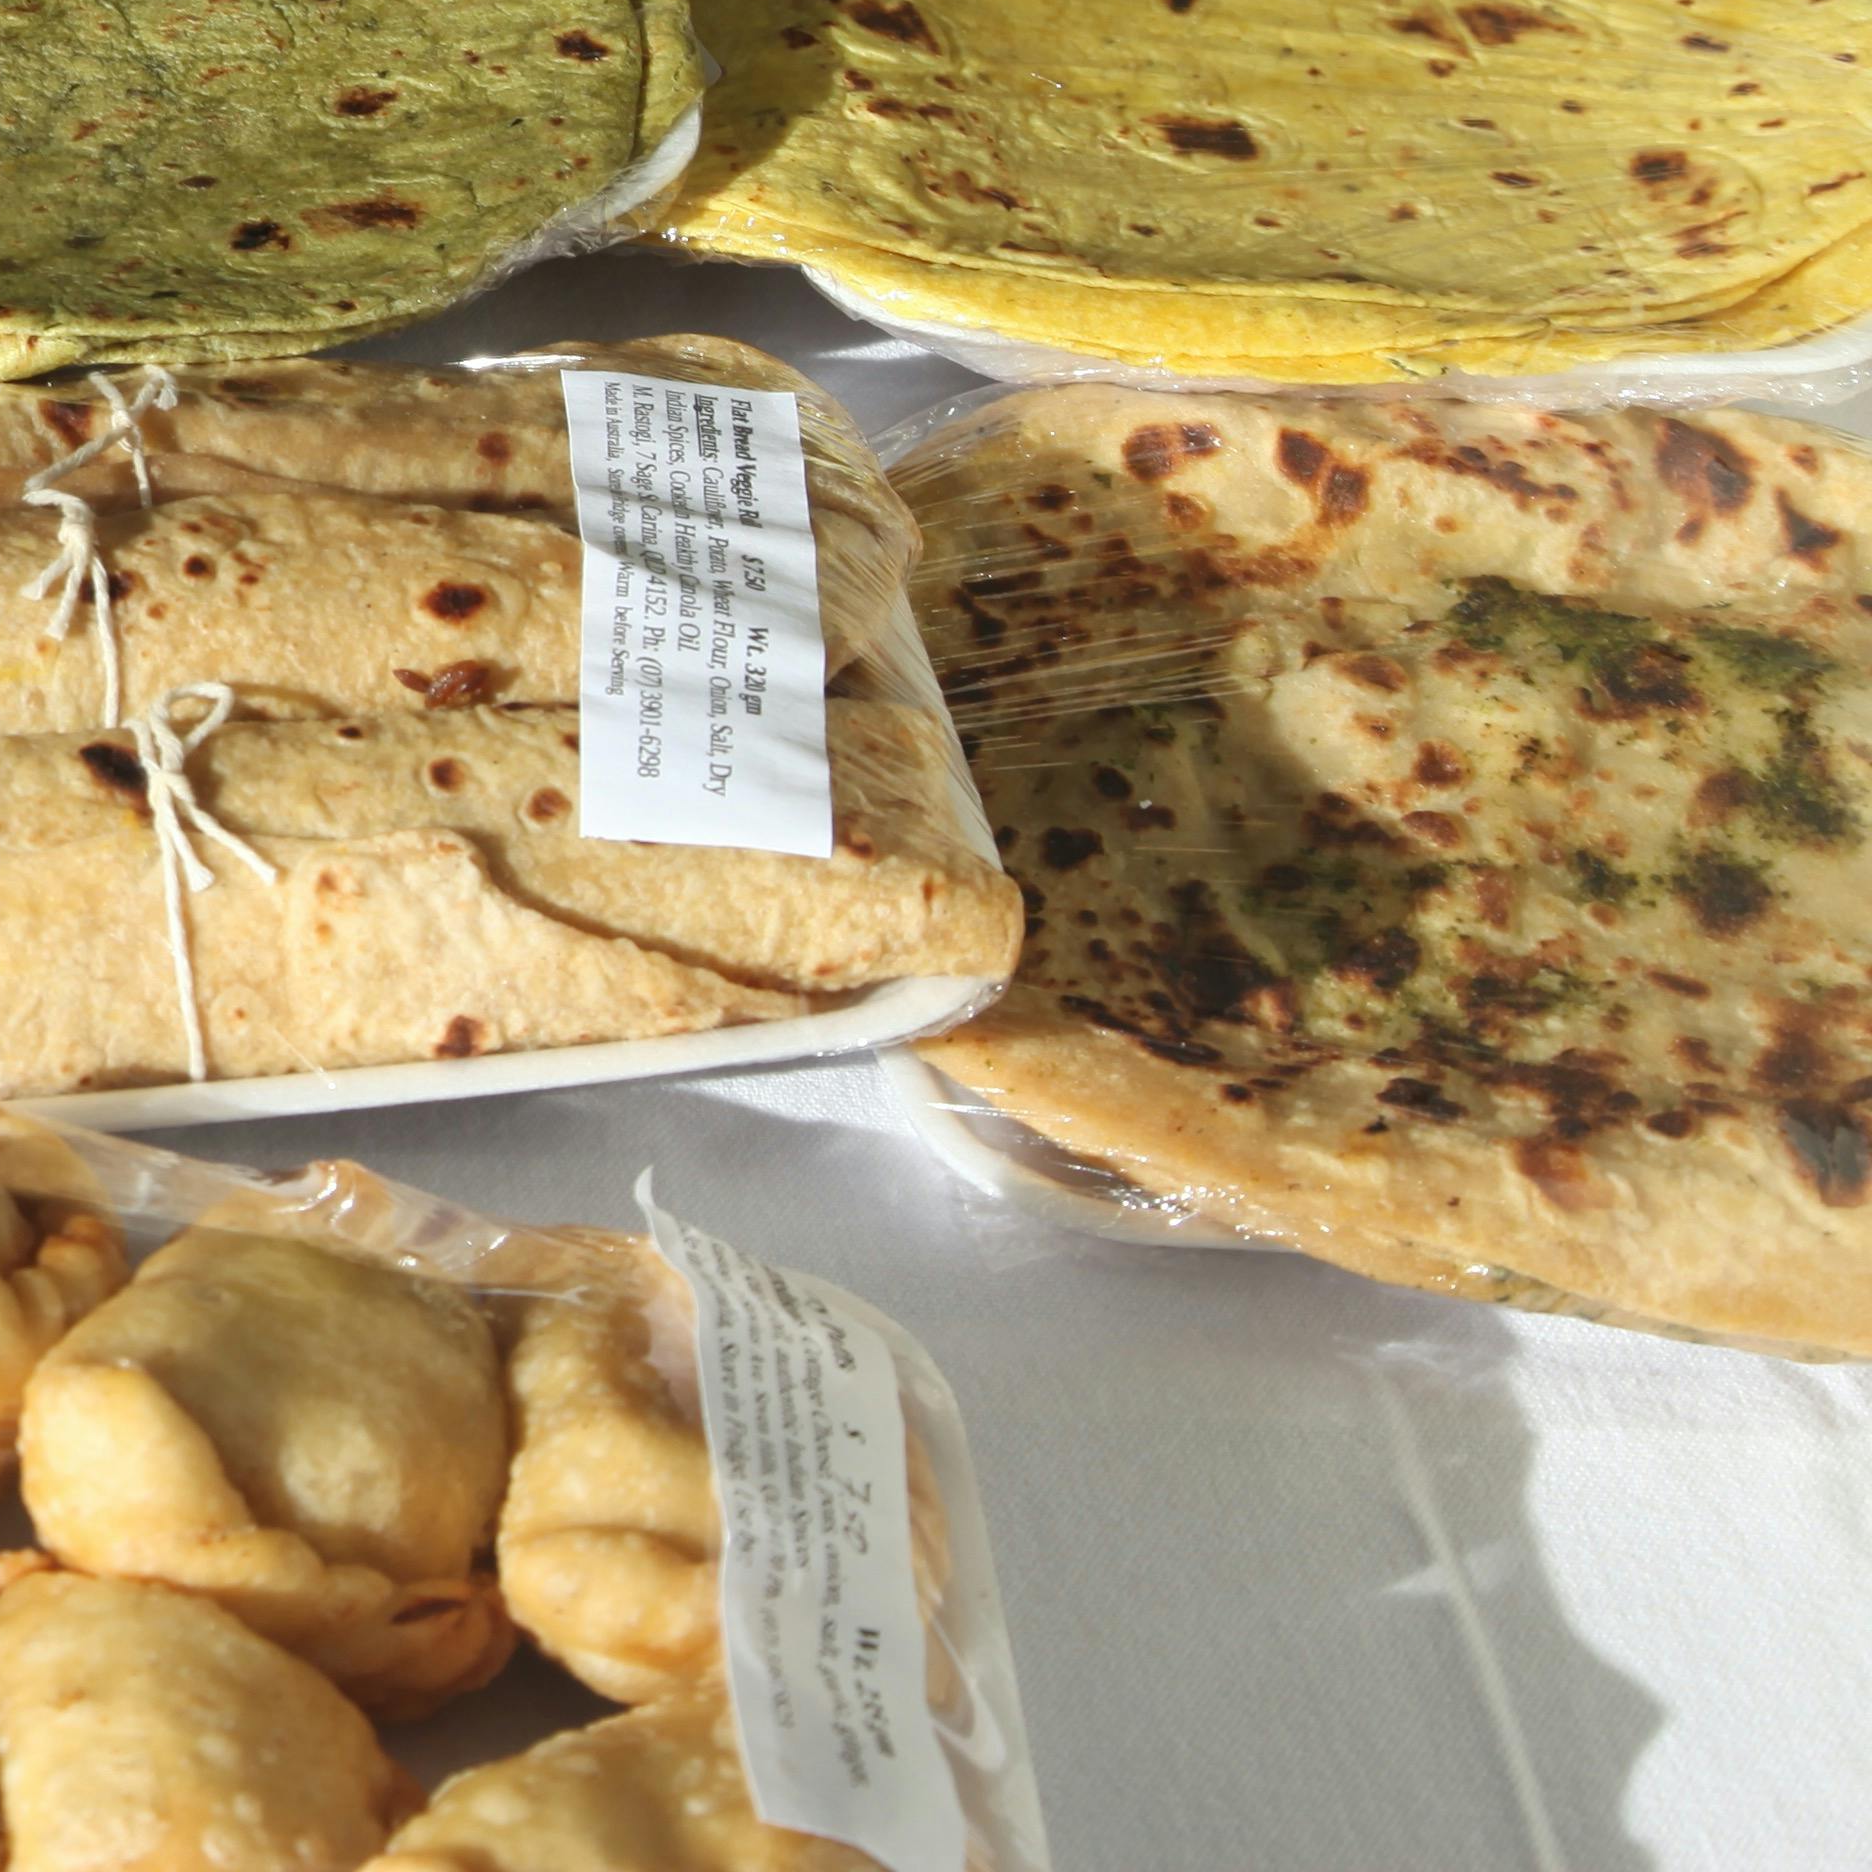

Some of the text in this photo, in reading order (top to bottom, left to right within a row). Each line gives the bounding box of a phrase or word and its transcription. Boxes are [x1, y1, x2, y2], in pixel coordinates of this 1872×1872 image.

[603, 381, 622, 405] Made
[631, 384, 653, 398] M.
[664, 389, 686, 423] Indian
[604, 406, 622, 416] in
[629, 402, 655, 446] Rastogi,
[693, 394, 719, 462] Ingredients:
[730, 398, 752, 423] Flat
[605, 420, 624, 461] Australia,
[635, 450, 657, 461] 7
[662, 426, 689, 465] Spices,
[732, 424, 756, 461] Bread
[630, 463, 656, 491] Sage
[729, 464, 758, 507] Veggie
[640, 505, 662, 546] Carina,
[615, 561, 633, 597] Warm
[643, 576, 667, 619] 4152.
[612, 606, 632, 645] before
[642, 626, 666, 651] Ph:
[745, 627, 768, 657] Wt.
[707, 621, 736, 669] Flour,
[605, 648, 630, 695] Serving
[634, 657, 663, 688] (07)
[743, 663, 766, 692] 320
[706, 677, 732, 718] Onion,
[739, 694, 762, 716] gm
[637, 691, 663, 778] 3901-6298
[706, 724, 733, 757] Salt,
[701, 763, 732, 795] Dry
